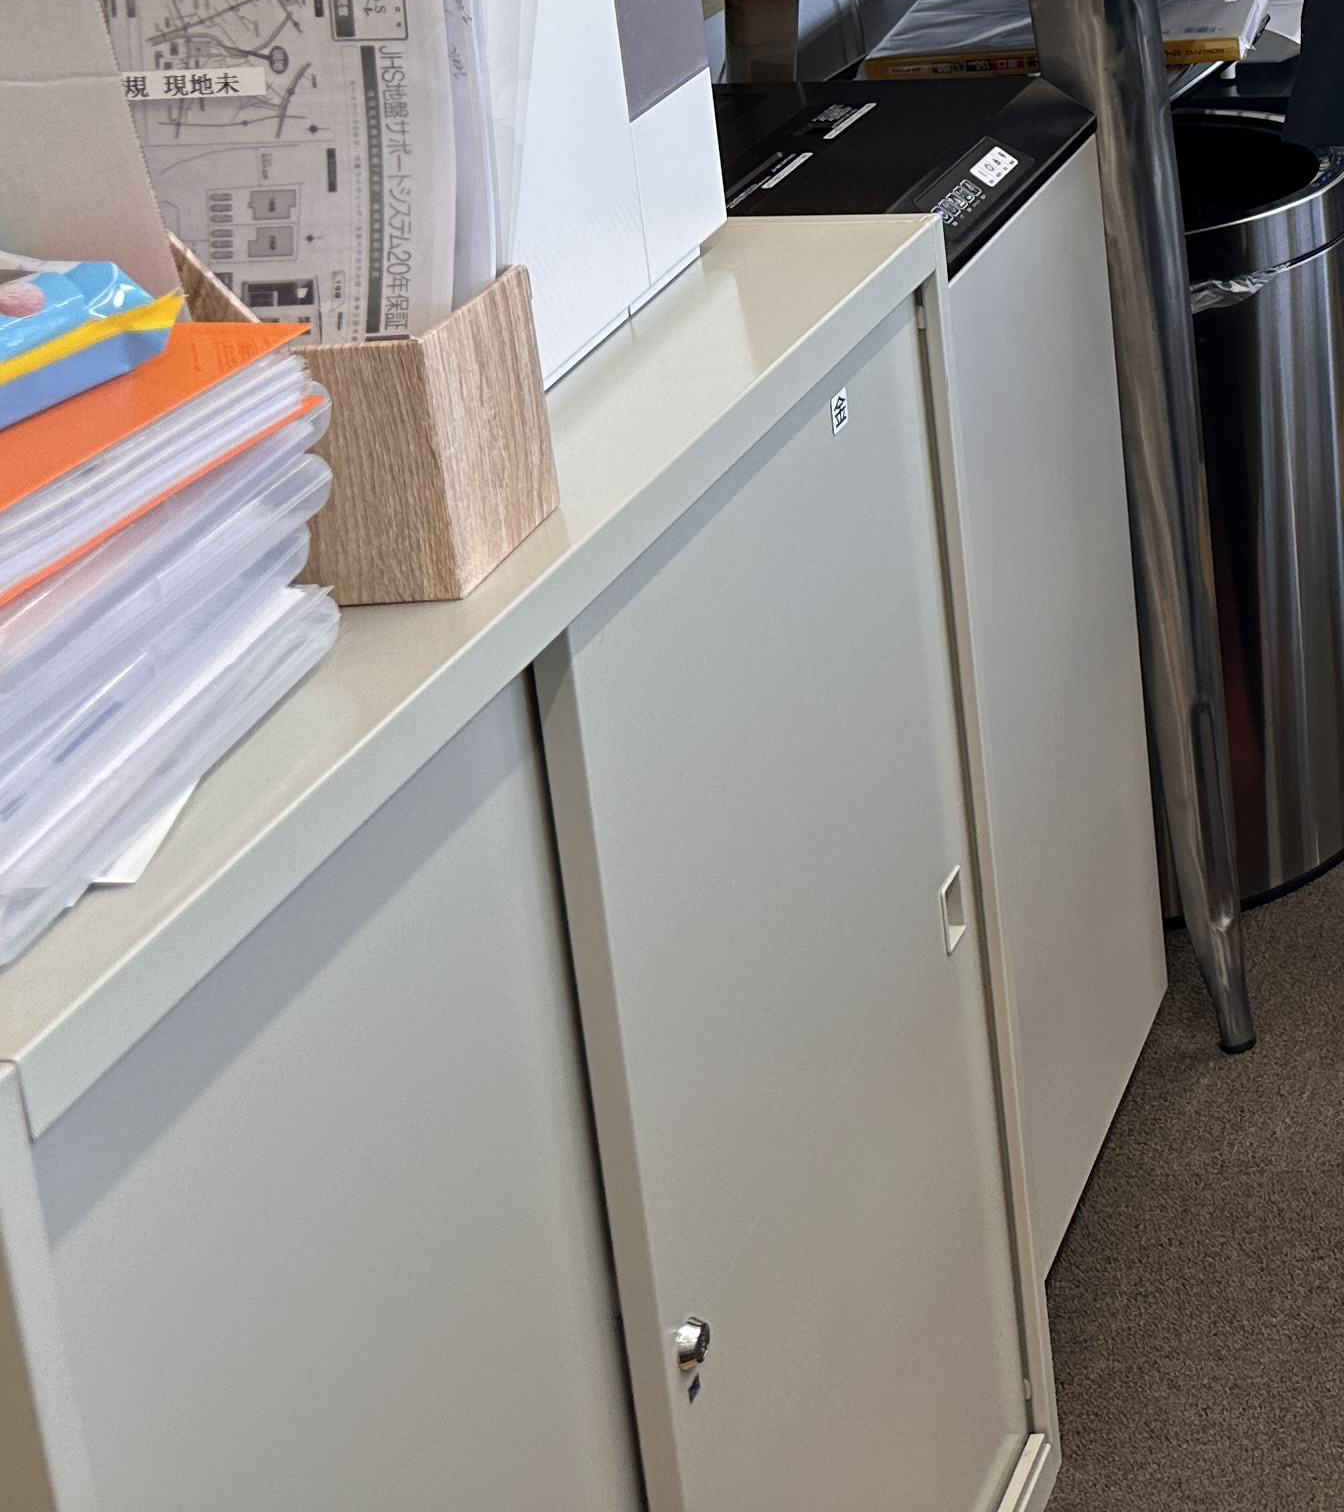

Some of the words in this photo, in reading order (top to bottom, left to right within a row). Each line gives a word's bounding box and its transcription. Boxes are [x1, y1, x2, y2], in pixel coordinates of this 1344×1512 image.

[164, 73, 240, 97] 現地未
[379, 46, 412, 331] JHS地盤サポートシステム20年保証
